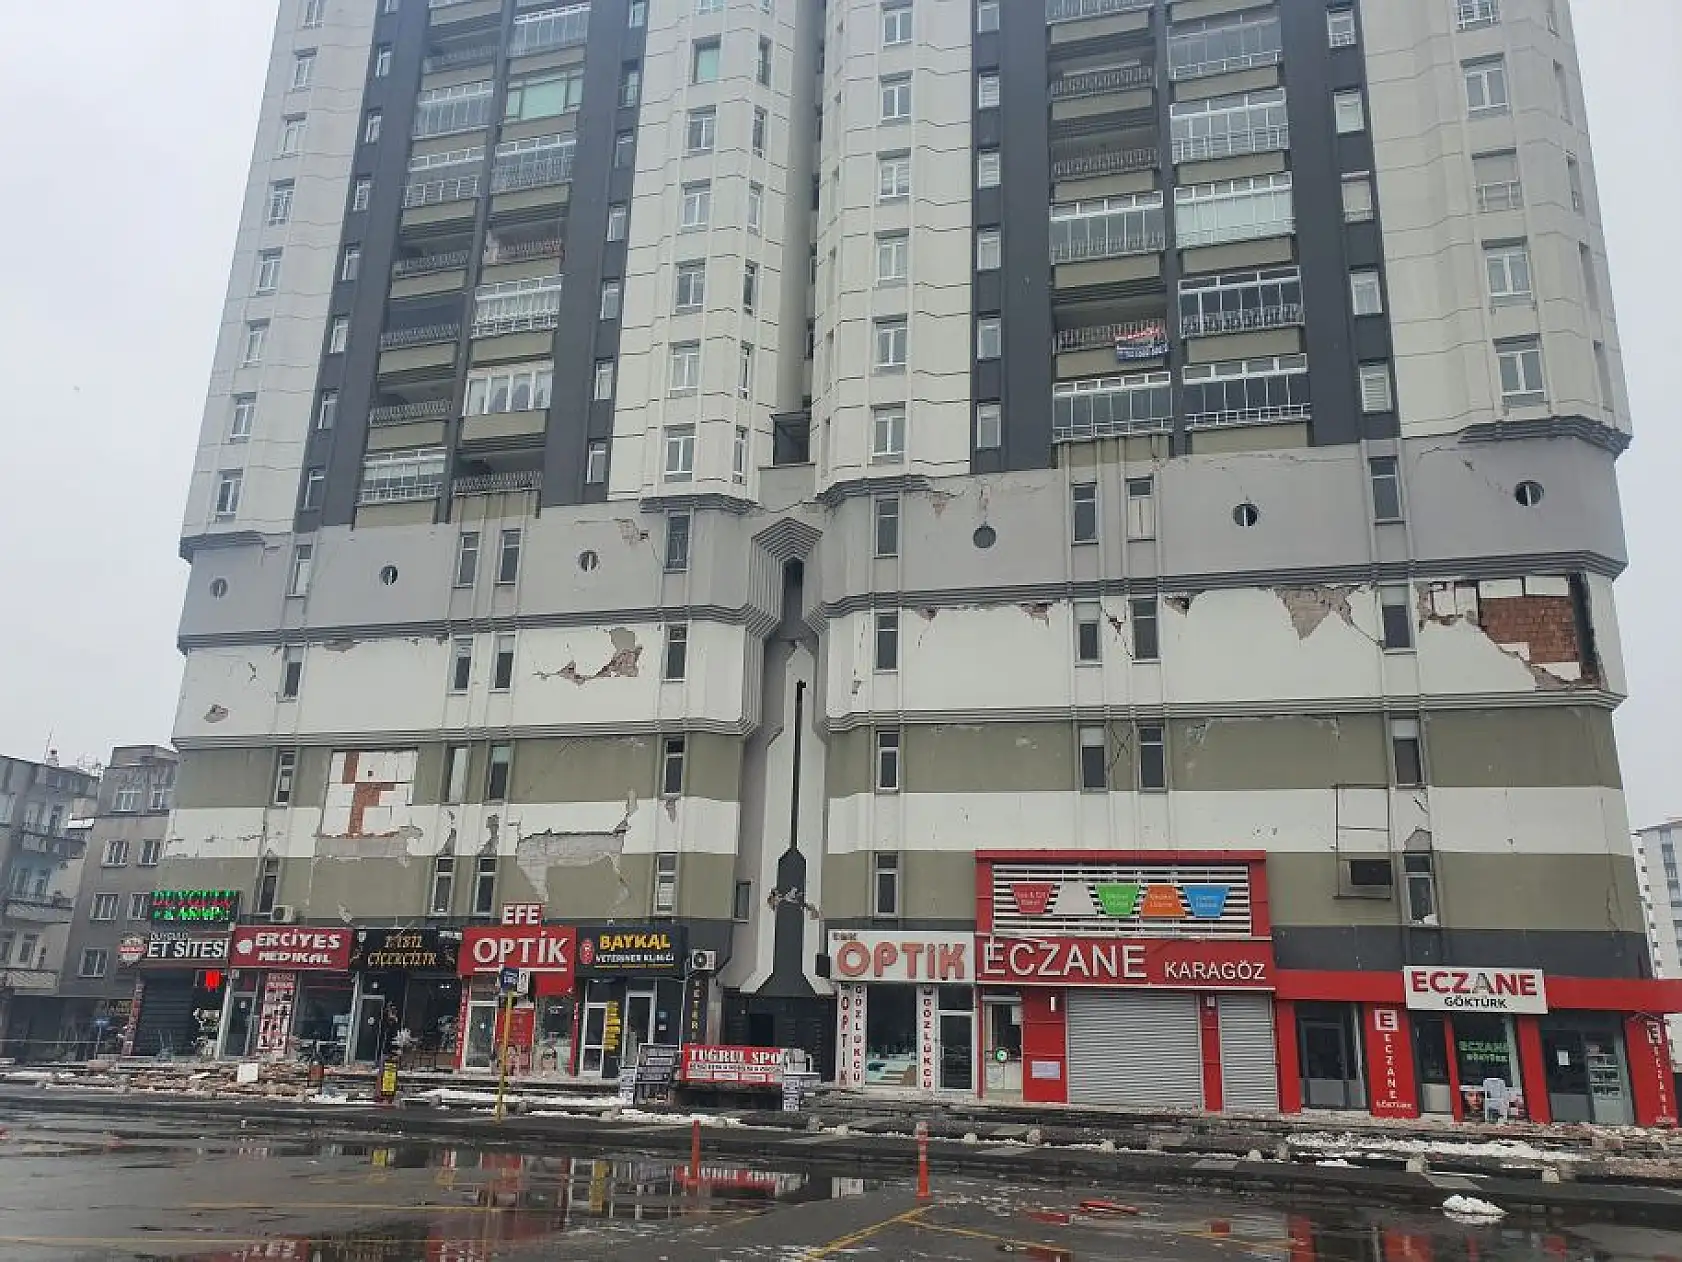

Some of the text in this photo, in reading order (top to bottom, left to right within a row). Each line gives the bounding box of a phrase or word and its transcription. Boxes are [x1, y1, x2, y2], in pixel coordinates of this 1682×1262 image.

[502, 904, 540, 925] EFE
[147, 941, 170, 958] ET
[255, 929, 341, 949] ERCİYES
[473, 931, 569, 963] OPTİK
[599, 933, 671, 951] BAYKAL
[983, 943, 1148, 978] ECZANE
[1164, 960, 1267, 981] KARAGÖZ
[1411, 970, 1538, 996] ECZANE
[1444, 994, 1508, 1009] GÖKTÜRK
